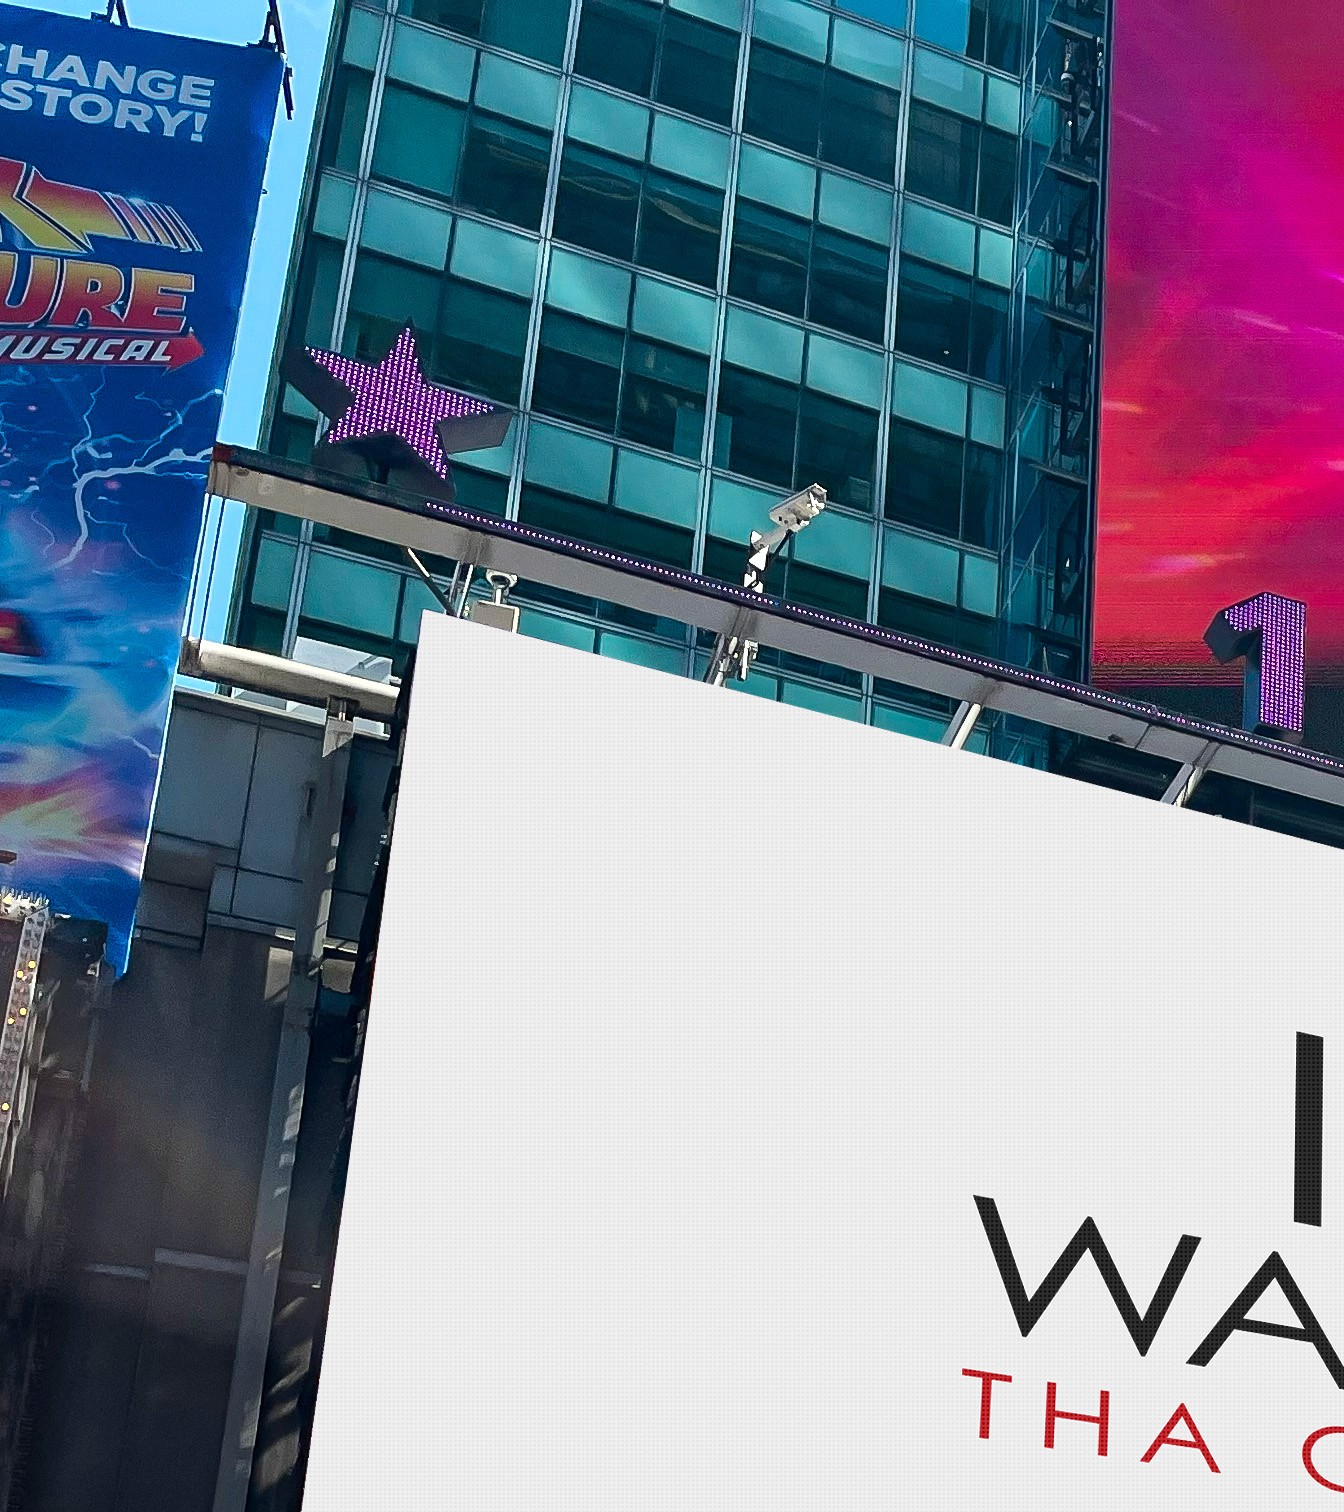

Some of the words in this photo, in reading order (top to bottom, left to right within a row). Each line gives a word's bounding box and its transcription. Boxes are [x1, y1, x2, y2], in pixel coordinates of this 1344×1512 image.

[0, 44, 214, 107] HANGE
[0, 78, 208, 142] STORY!
[0, 335, 172, 361] USICAL
[961, 1368, 1221, 1474] THA
